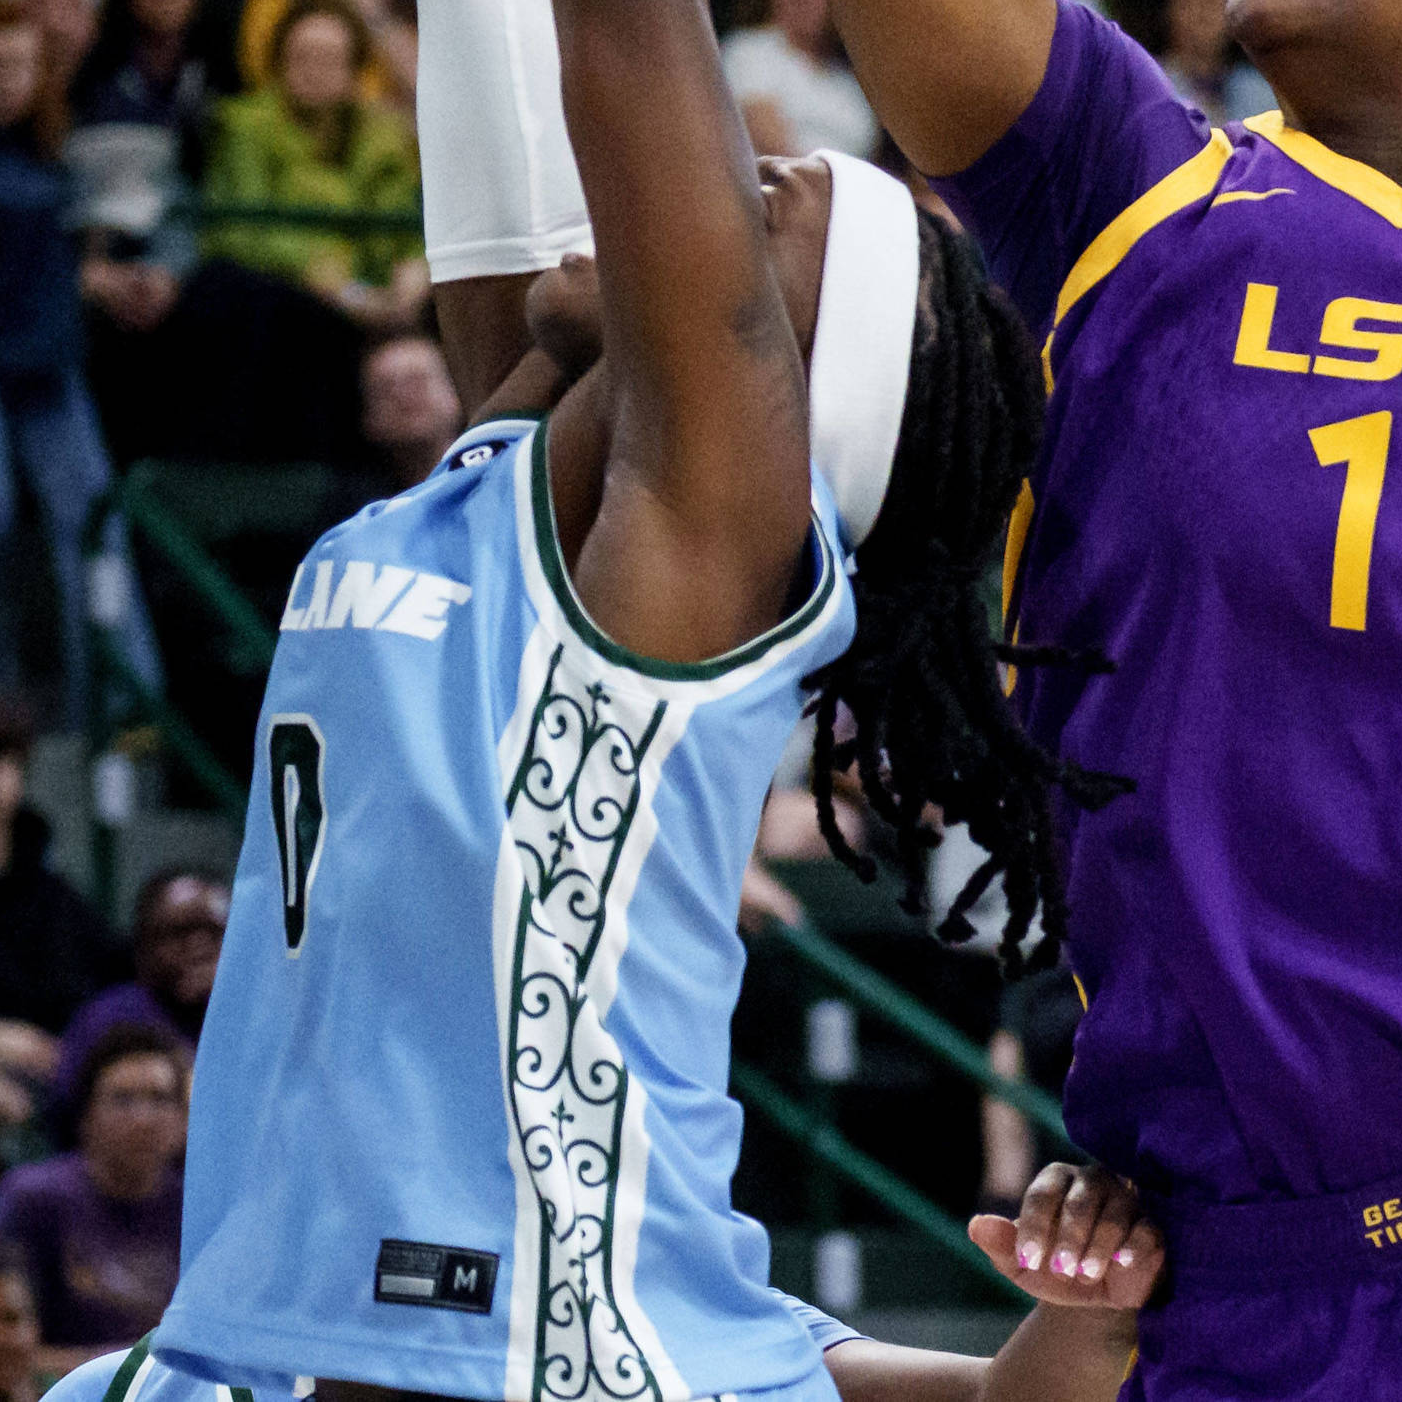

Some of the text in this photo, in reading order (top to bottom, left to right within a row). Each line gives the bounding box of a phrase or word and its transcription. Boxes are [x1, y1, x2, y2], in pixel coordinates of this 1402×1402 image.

[1308, 410, 1393, 632] 1
[279, 559, 473, 641] LANE
[266, 712, 328, 959] 0
[453, 1265, 477, 1294] M
